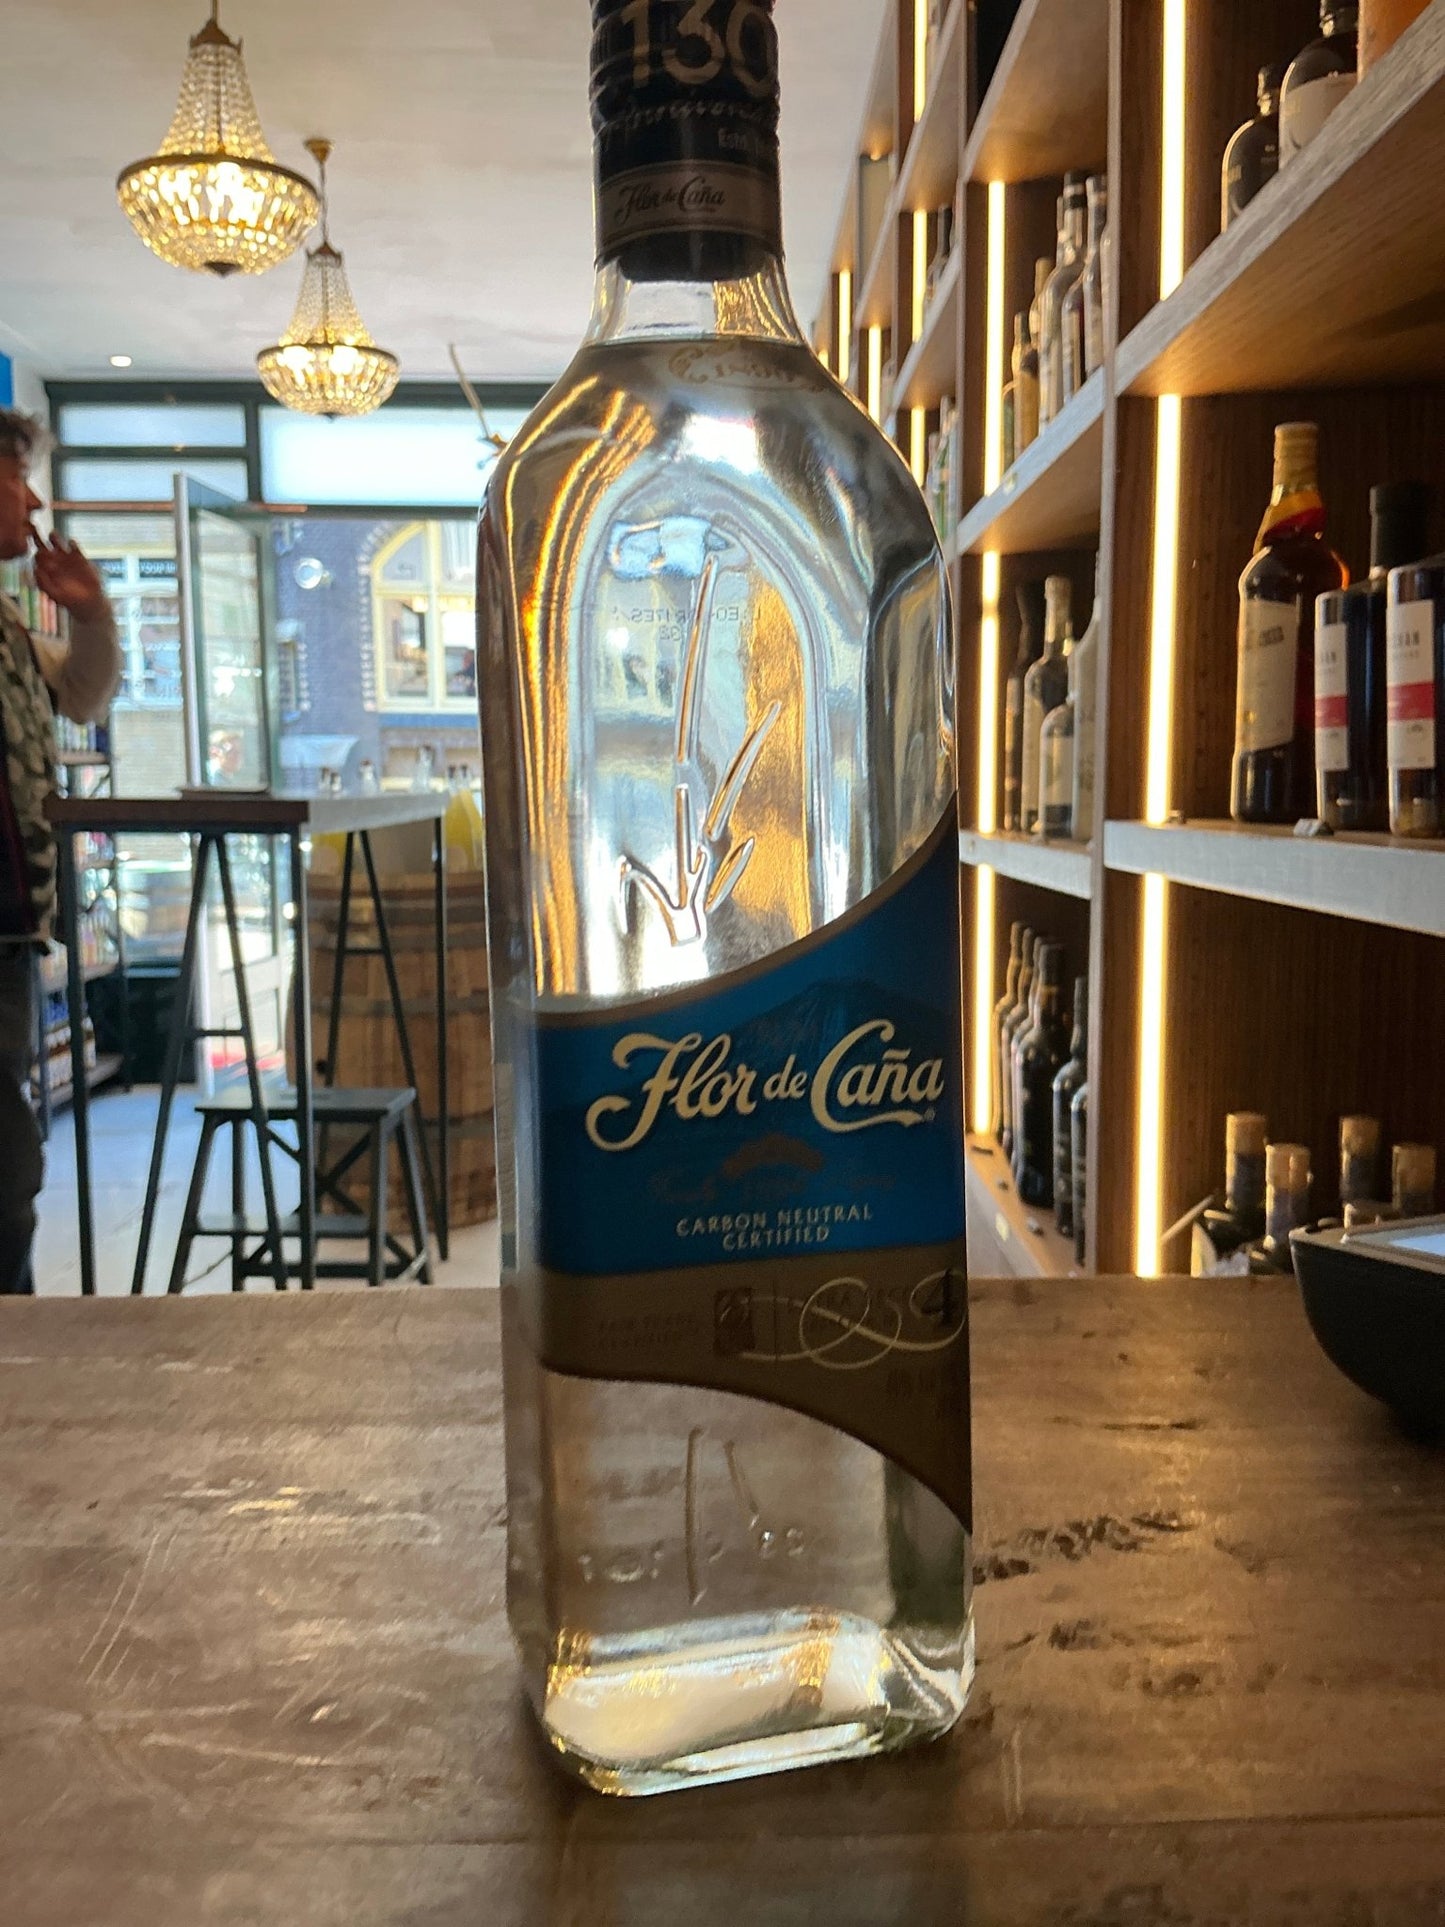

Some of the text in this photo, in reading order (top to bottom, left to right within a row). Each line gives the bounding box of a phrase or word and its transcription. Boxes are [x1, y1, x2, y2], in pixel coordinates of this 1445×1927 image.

[614, 182, 661, 224] Flor
[678, 175, 725, 214] Caña
[585, 1018, 944, 1152] Flor de Caña
[676, 1203, 874, 1237] CARBON NEUTRAL
[722, 1226, 830, 1252] CERTIFIED
